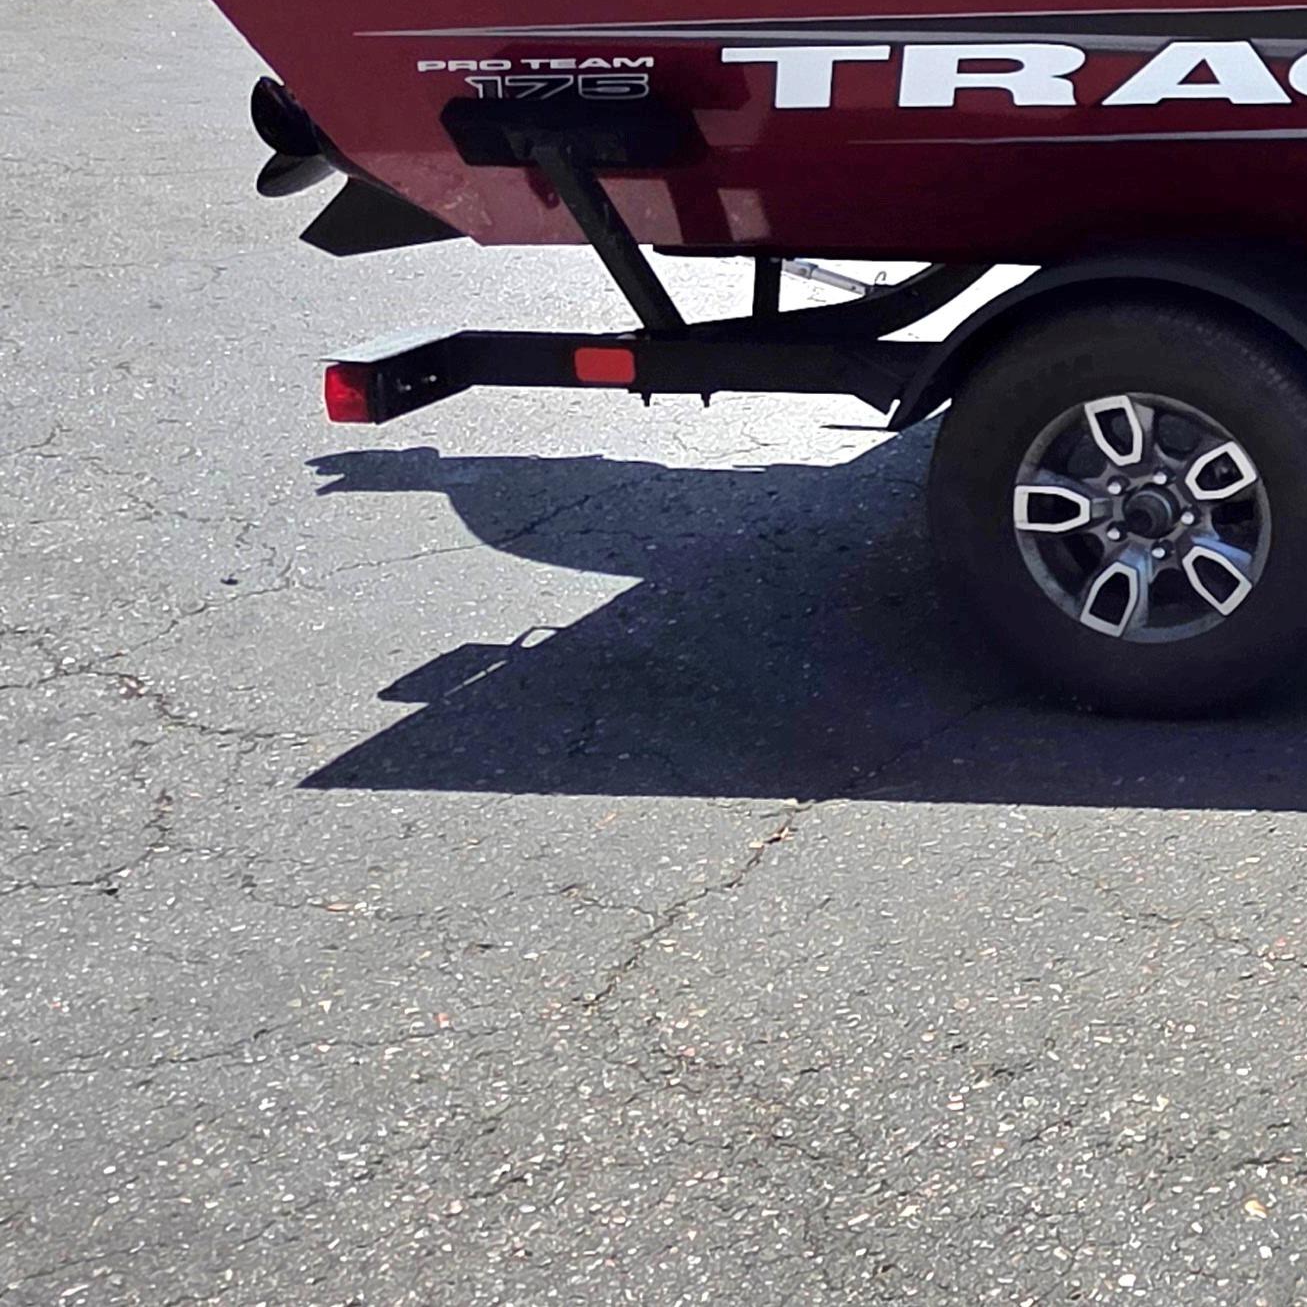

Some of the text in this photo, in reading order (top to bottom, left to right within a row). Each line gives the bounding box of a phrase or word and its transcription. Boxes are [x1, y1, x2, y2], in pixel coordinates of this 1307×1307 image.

[417, 56, 655, 72] PRO TEAM
[464, 73, 650, 101] 175
